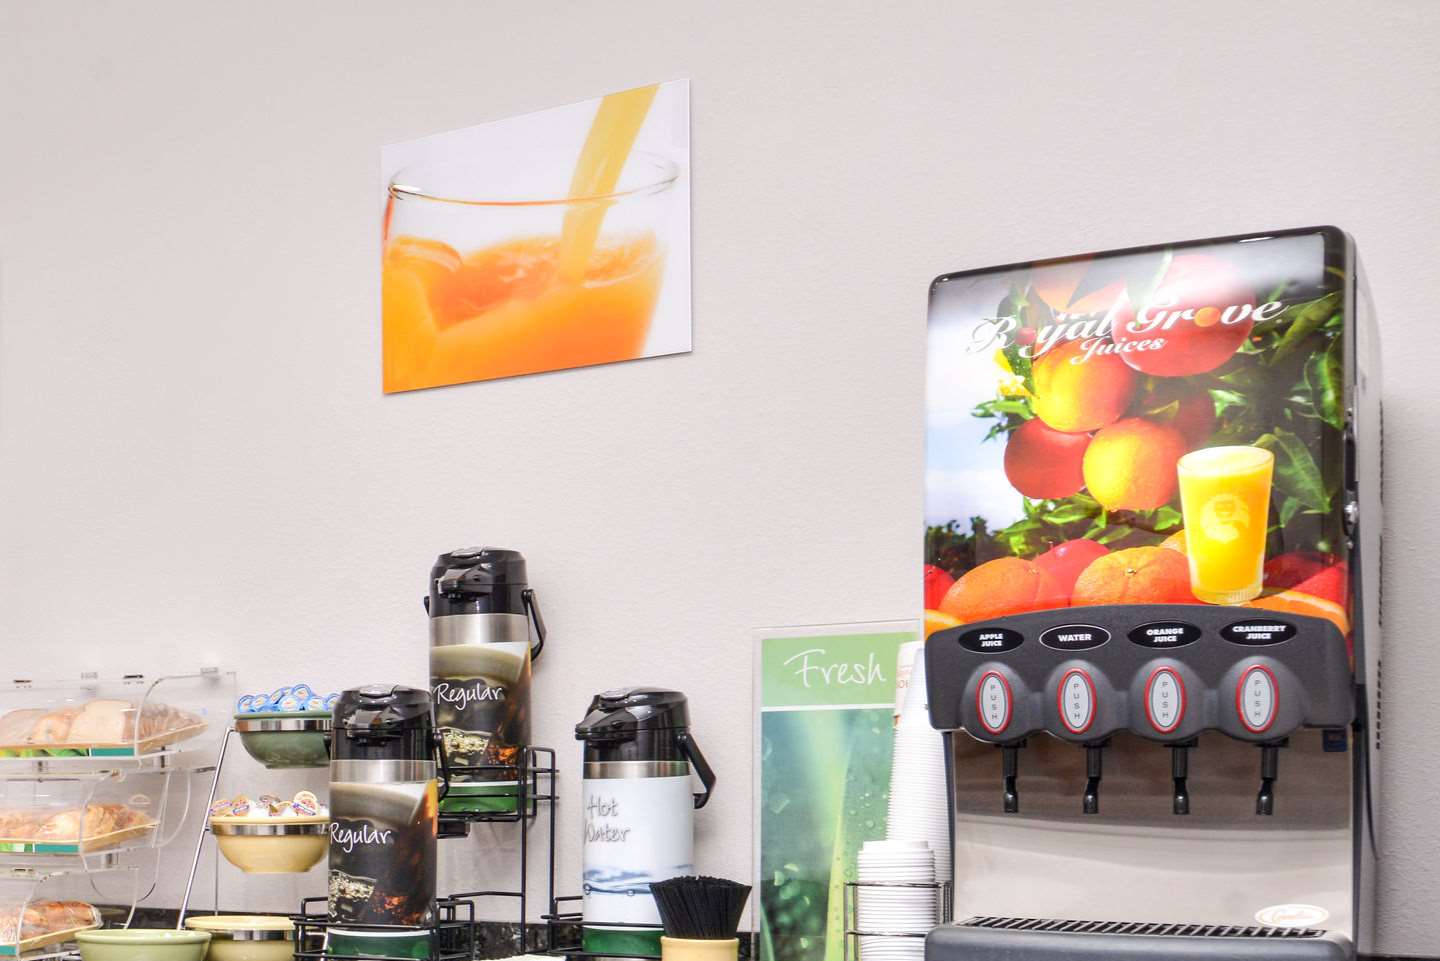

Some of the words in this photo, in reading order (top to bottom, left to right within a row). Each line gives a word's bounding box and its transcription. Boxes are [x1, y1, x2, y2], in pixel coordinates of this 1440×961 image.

[1071, 336, 1167, 365] Juices
[979, 633, 1004, 641] APPLE
[1057, 633, 1092, 642] WATER
[1146, 627, 1184, 636] ORANGE
[1153, 635, 1178, 643] JUICE
[1232, 625, 1287, 633] CRANBERRY
[1245, 632, 1272, 640] JUICE
[783, 648, 887, 688] Fresh
[433, 683, 503, 711] Regular
[990, 684, 999, 720] PUSH
[1073, 683, 1081, 719] PUSH
[1161, 681, 1169, 719] PUSH
[1253, 679, 1261, 718] PUSH
[587, 794, 619, 820] Hot
[328, 822, 391, 853] Regular
